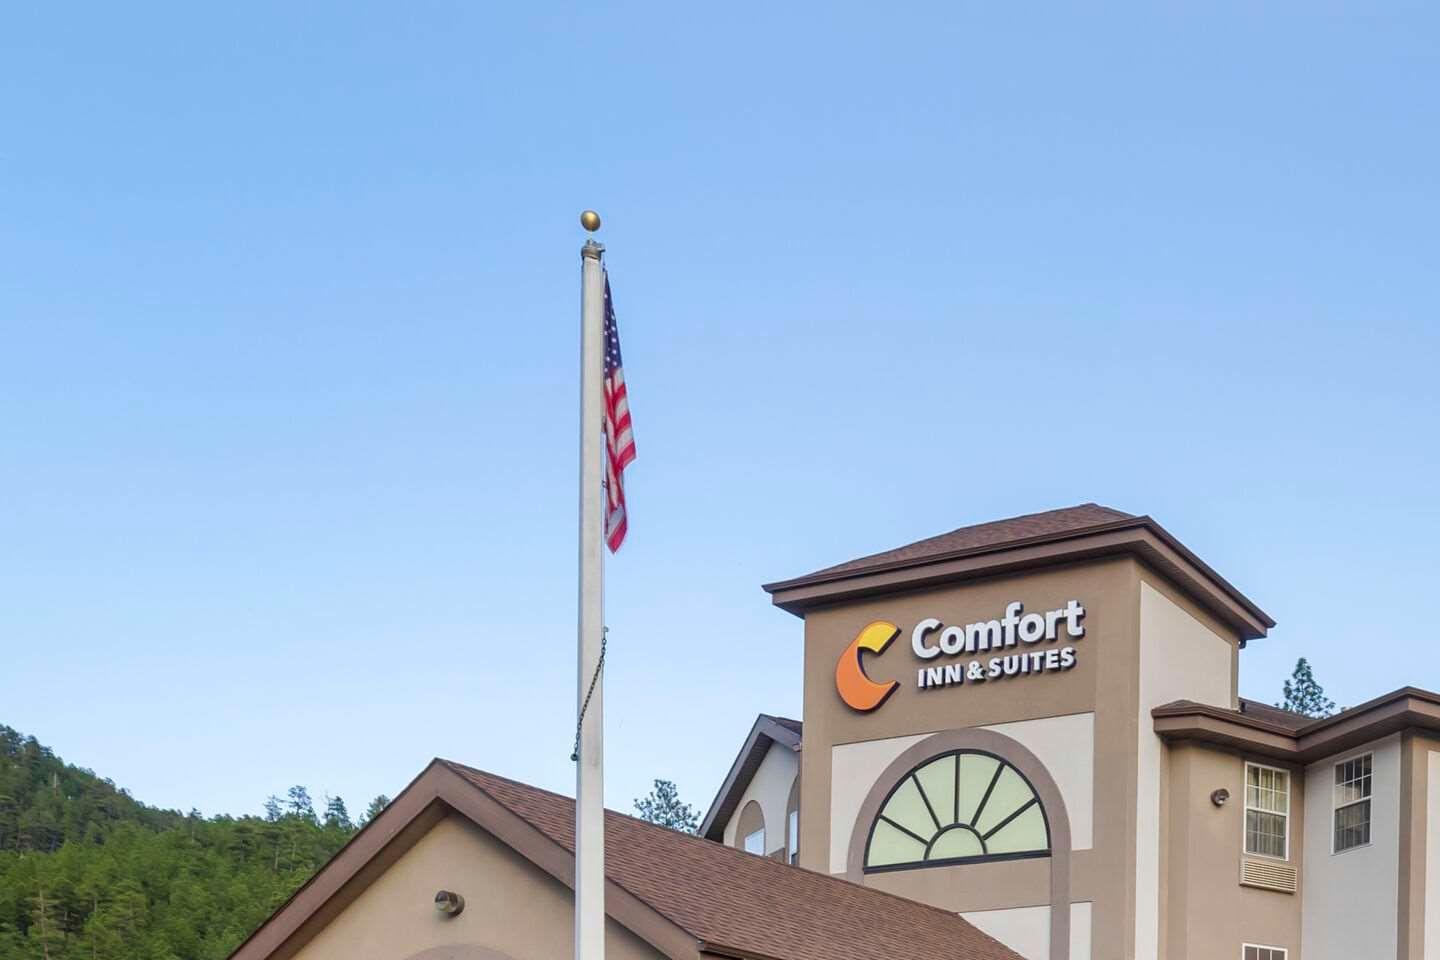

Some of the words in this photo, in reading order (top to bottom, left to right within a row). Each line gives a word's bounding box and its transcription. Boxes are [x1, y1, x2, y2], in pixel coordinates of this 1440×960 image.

[911, 600, 1085, 660] Comfort
[918, 663, 963, 688] INN
[967, 660, 985, 681] &
[987, 647, 1076, 679] SUITES
